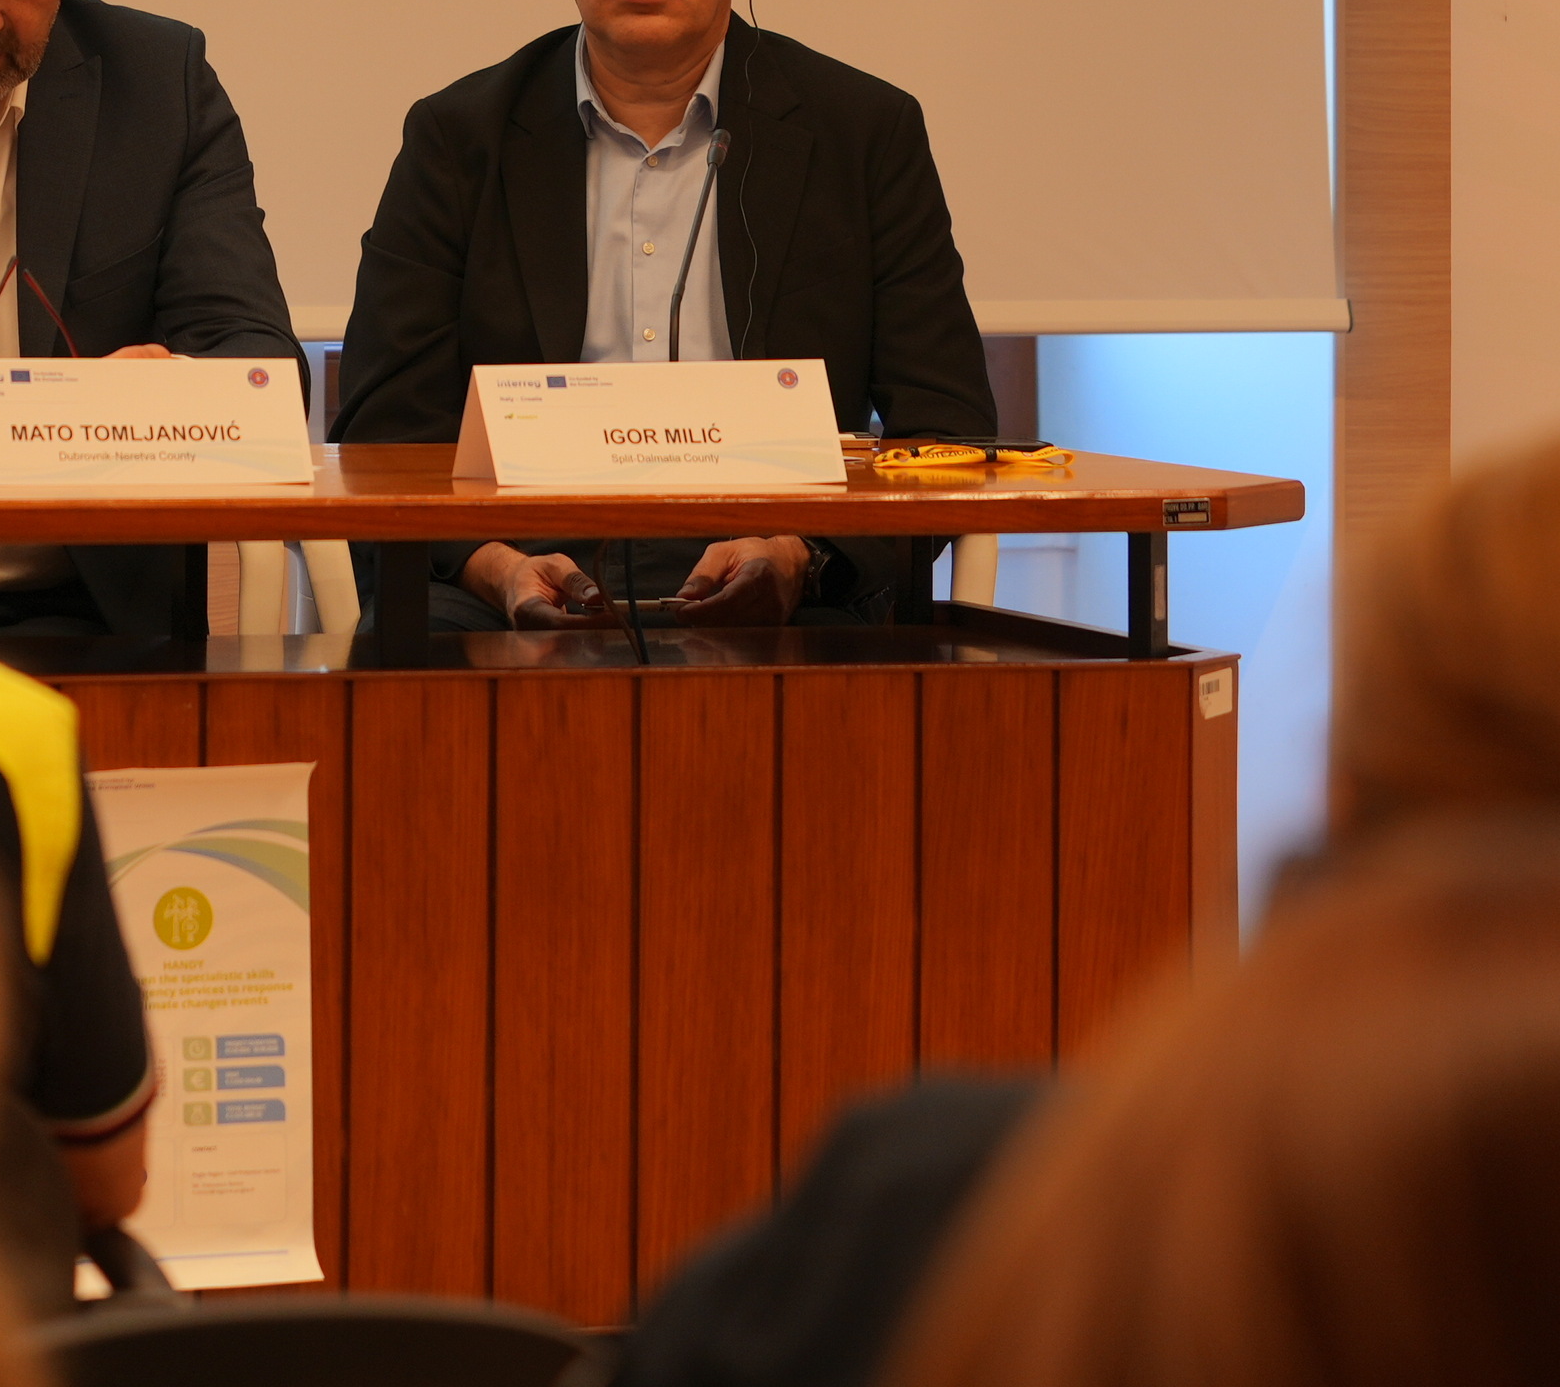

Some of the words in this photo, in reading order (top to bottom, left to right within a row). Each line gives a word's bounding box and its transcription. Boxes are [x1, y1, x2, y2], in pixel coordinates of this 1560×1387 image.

[11, 425, 74, 442] MATO
[80, 420, 241, 442] TOMLJANOVIĆ
[603, 428, 658, 445] IGOR
[664, 422, 723, 445] MILIĆ
[59, 451, 156, 461] Dubrovnik-Neretva
[159, 451, 196, 463] County
[611, 453, 681, 464] Split-Dalmatia
[683, 453, 719, 465] County
